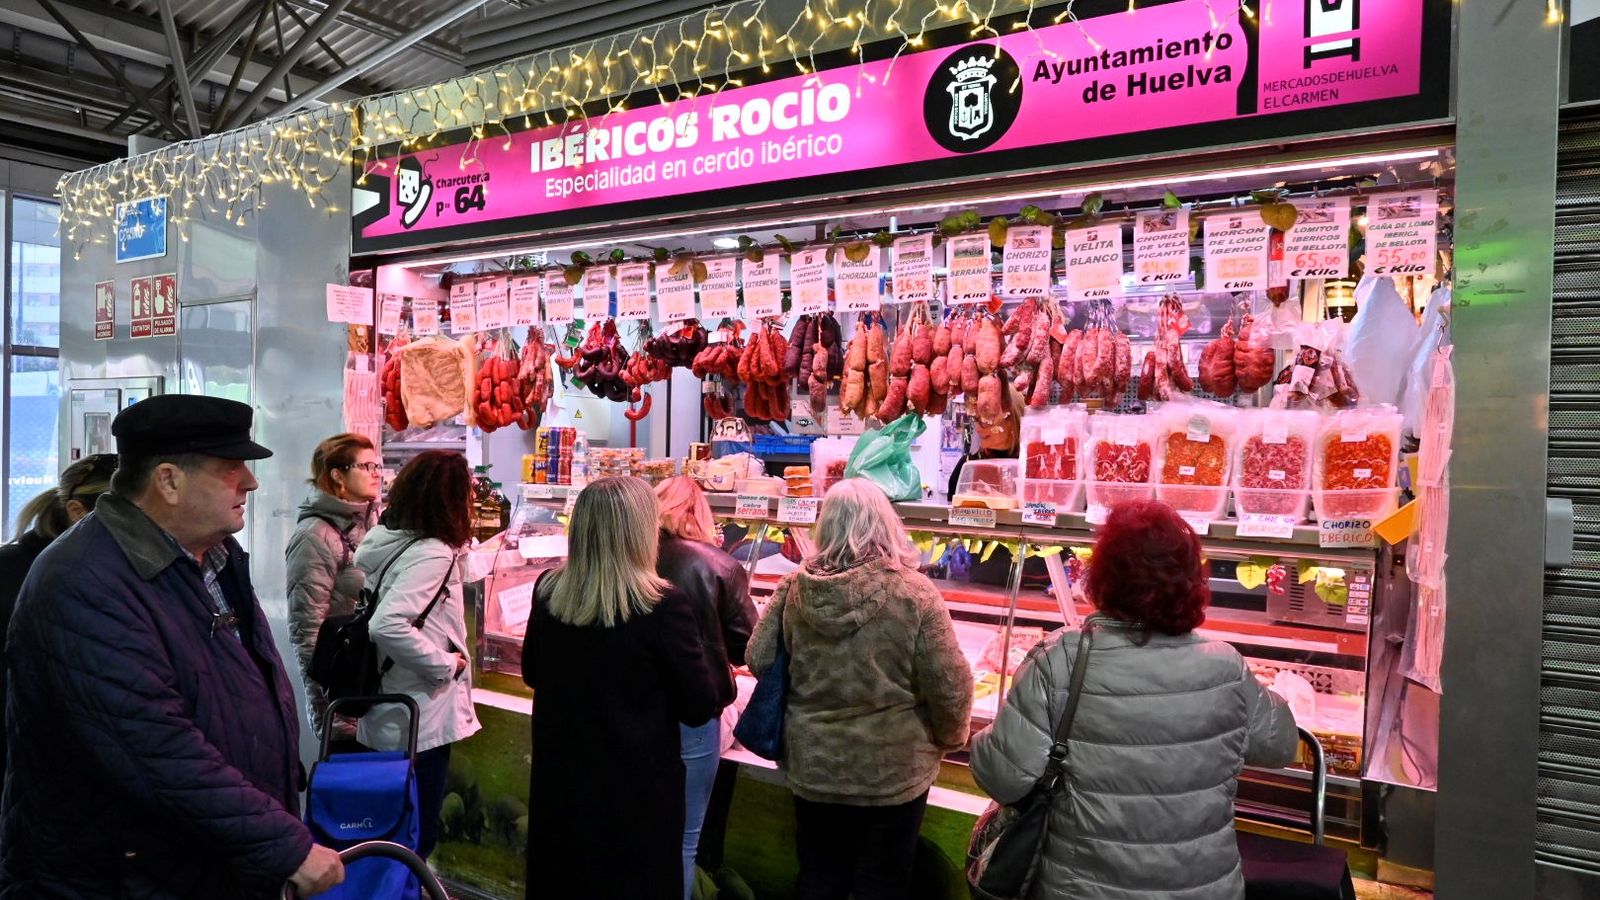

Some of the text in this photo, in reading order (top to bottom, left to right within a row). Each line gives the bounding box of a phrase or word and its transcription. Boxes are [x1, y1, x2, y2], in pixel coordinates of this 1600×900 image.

[1032, 31, 1233, 84] Ayuntamiento
[1082, 63, 1232, 104] de Huelva
[530, 77, 851, 173] IBÉRICOS ROCÍO
[545, 133, 842, 198] Especialidad en cerdo ibérico
[454, 184, 486, 214] 64
[1293, 225, 1339, 234] LOMITOS
[1368, 222, 1393, 231] CAÑA
[1408, 220, 1434, 228] LOMO
[1136, 231, 1187, 243] CHORIZO
[1292, 234, 1341, 243] IBERICOS
[1384, 230, 1419, 238] IBERICA
[1139, 240, 1186, 251] DE VELA
[1228, 236, 1265, 245] LOMO
[1375, 239, 1428, 249] DE BELLOTA
[1073, 240, 1114, 252] VELITA
[1210, 245, 1264, 255] IBERICO
[1303, 243, 1347, 251] BELLOTA
[1006, 250, 1049, 261] CHORIZO
[1137, 249, 1187, 259] PICANTE
[1377, 249, 1426, 266] 55,00
[1069, 253, 1119, 266] BLANCO
[1295, 252, 1341, 268] 65,00
[950, 267, 988, 277] SERRANO
[1007, 263, 1047, 273] DE VELA
[1305, 268, 1339, 276] Kilo
[1390, 265, 1426, 273] Kilo
[1153, 273, 1182, 281] Kilo
[1233, 280, 1254, 288] kilo
[1019, 287, 1043, 295] Kilo
[736, 507, 767, 517] serrano
[1322, 520, 1371, 530] CHORIZO
